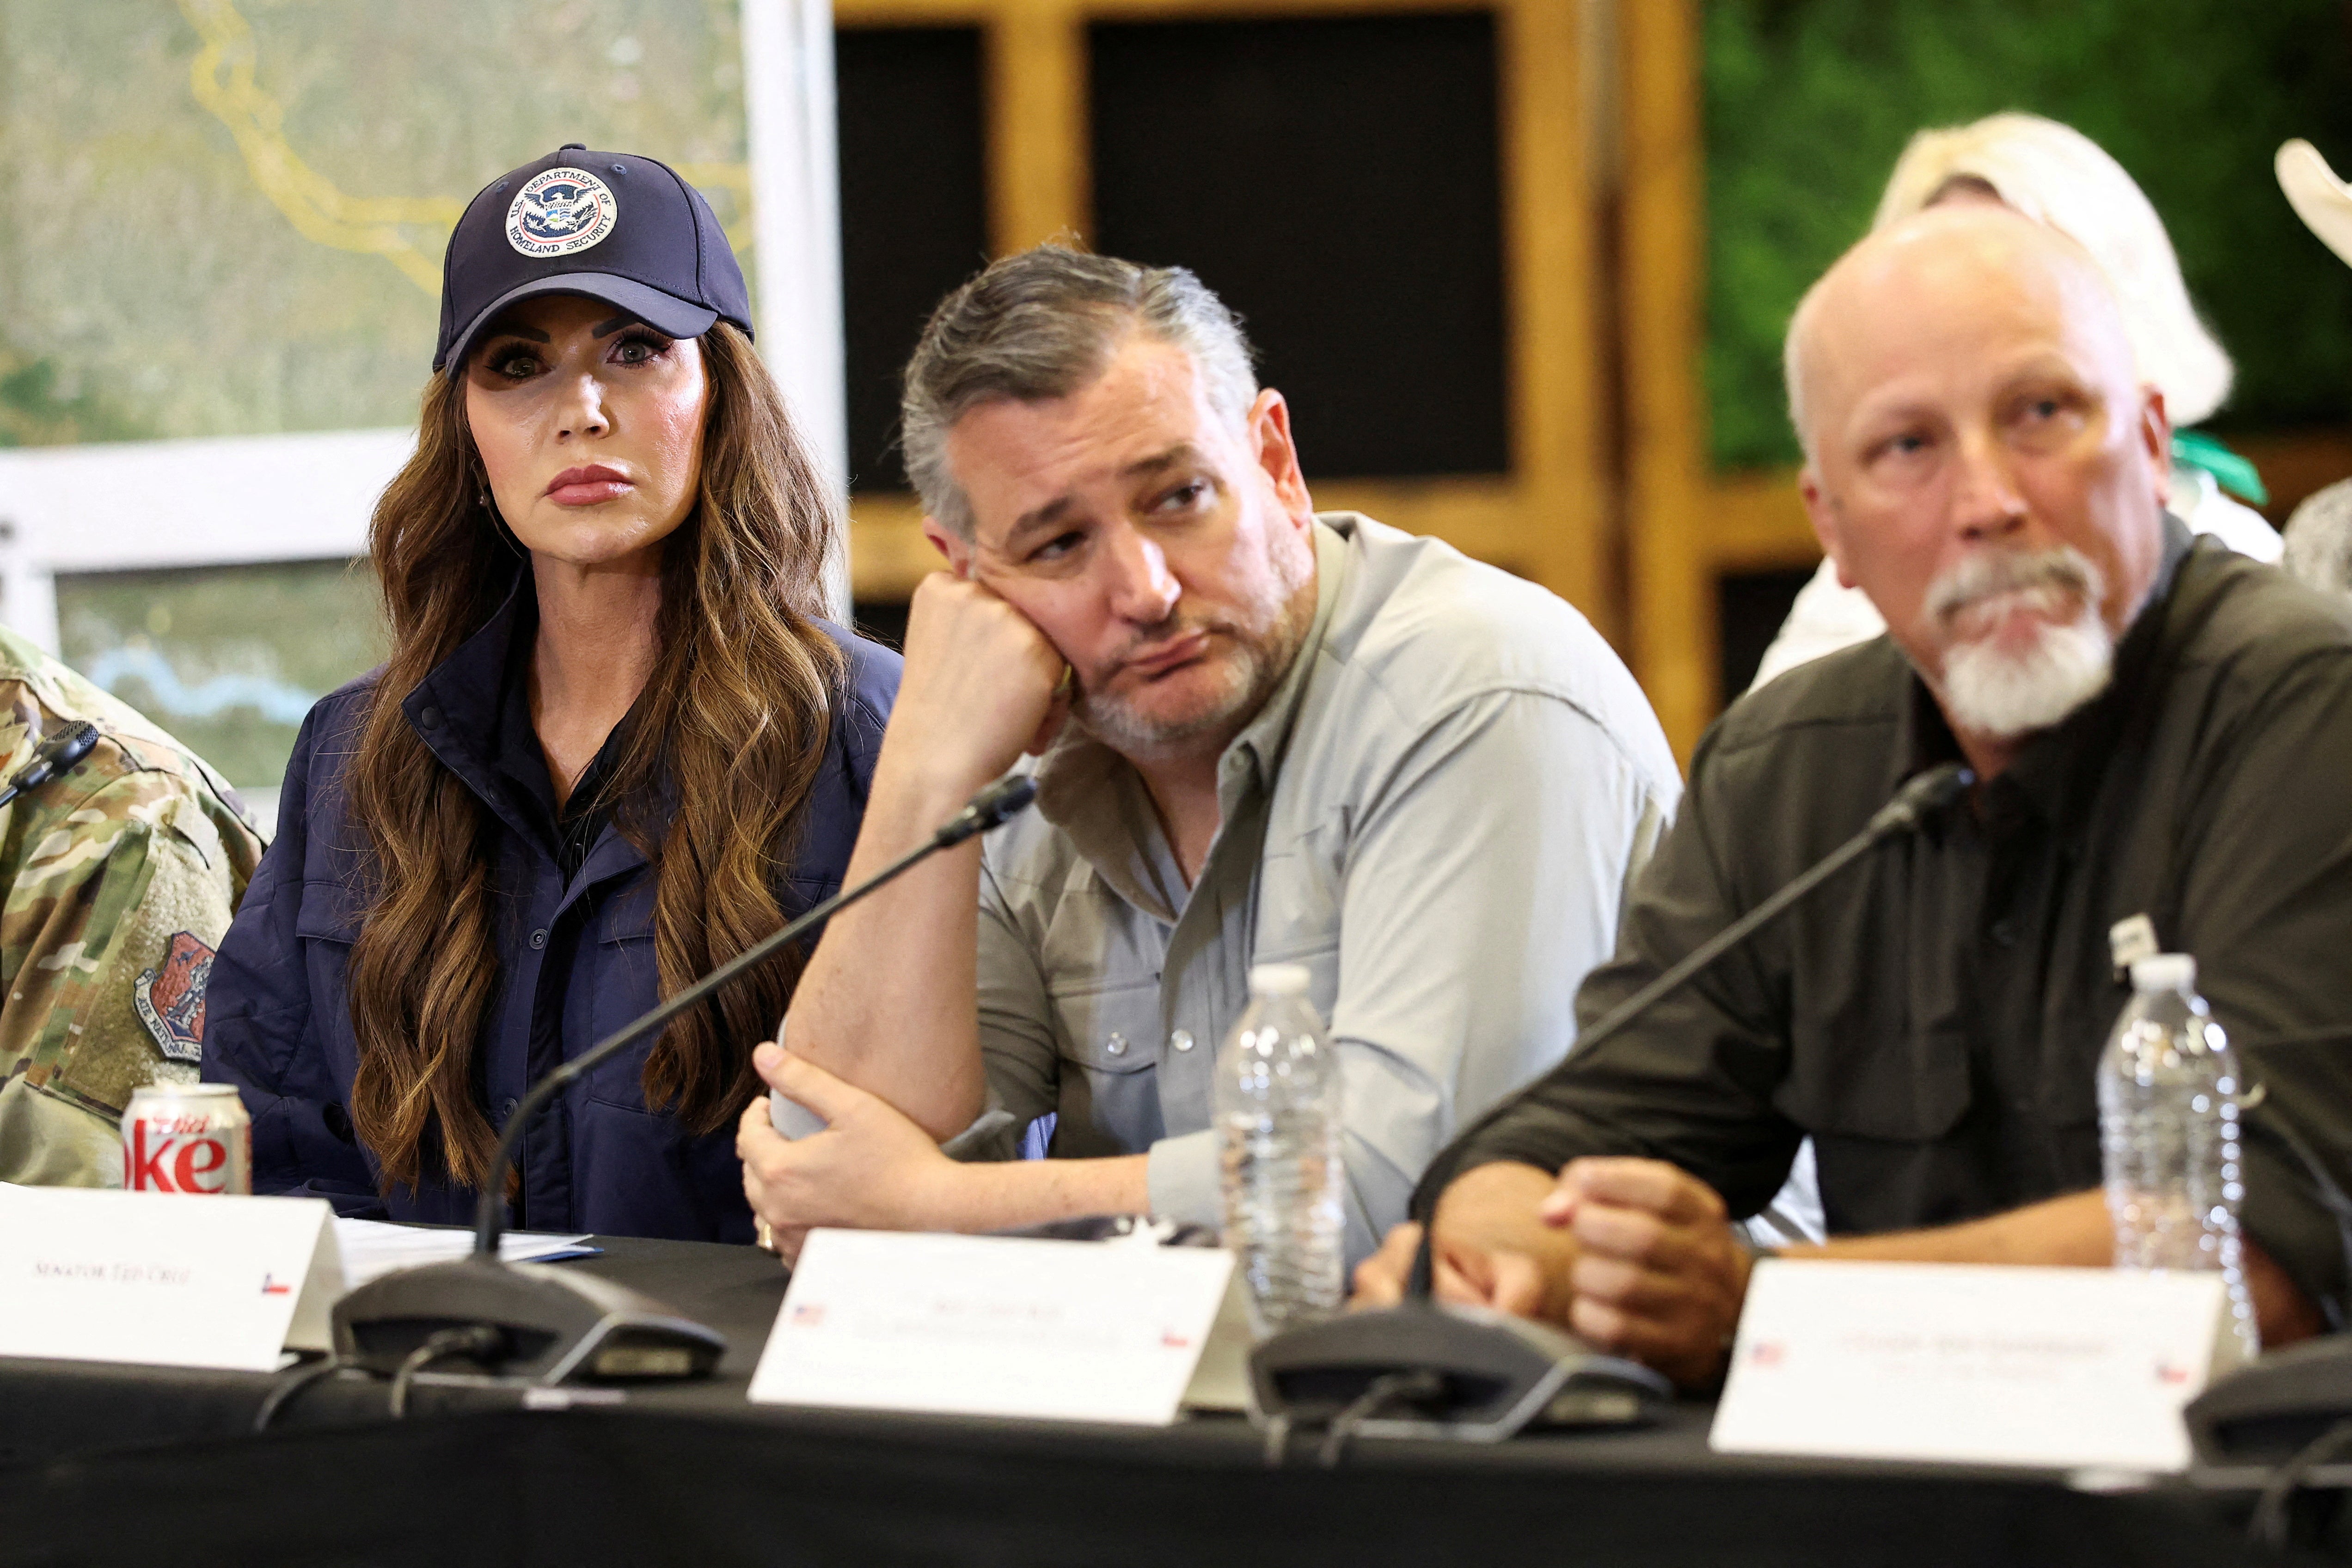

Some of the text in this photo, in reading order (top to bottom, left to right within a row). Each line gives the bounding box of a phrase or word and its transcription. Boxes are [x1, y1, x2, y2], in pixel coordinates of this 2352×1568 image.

[526, 171, 601, 192] DEPARTMENT
[599, 193, 612, 207] OF
[510, 214, 611, 253] HOMELAND SECURITY
